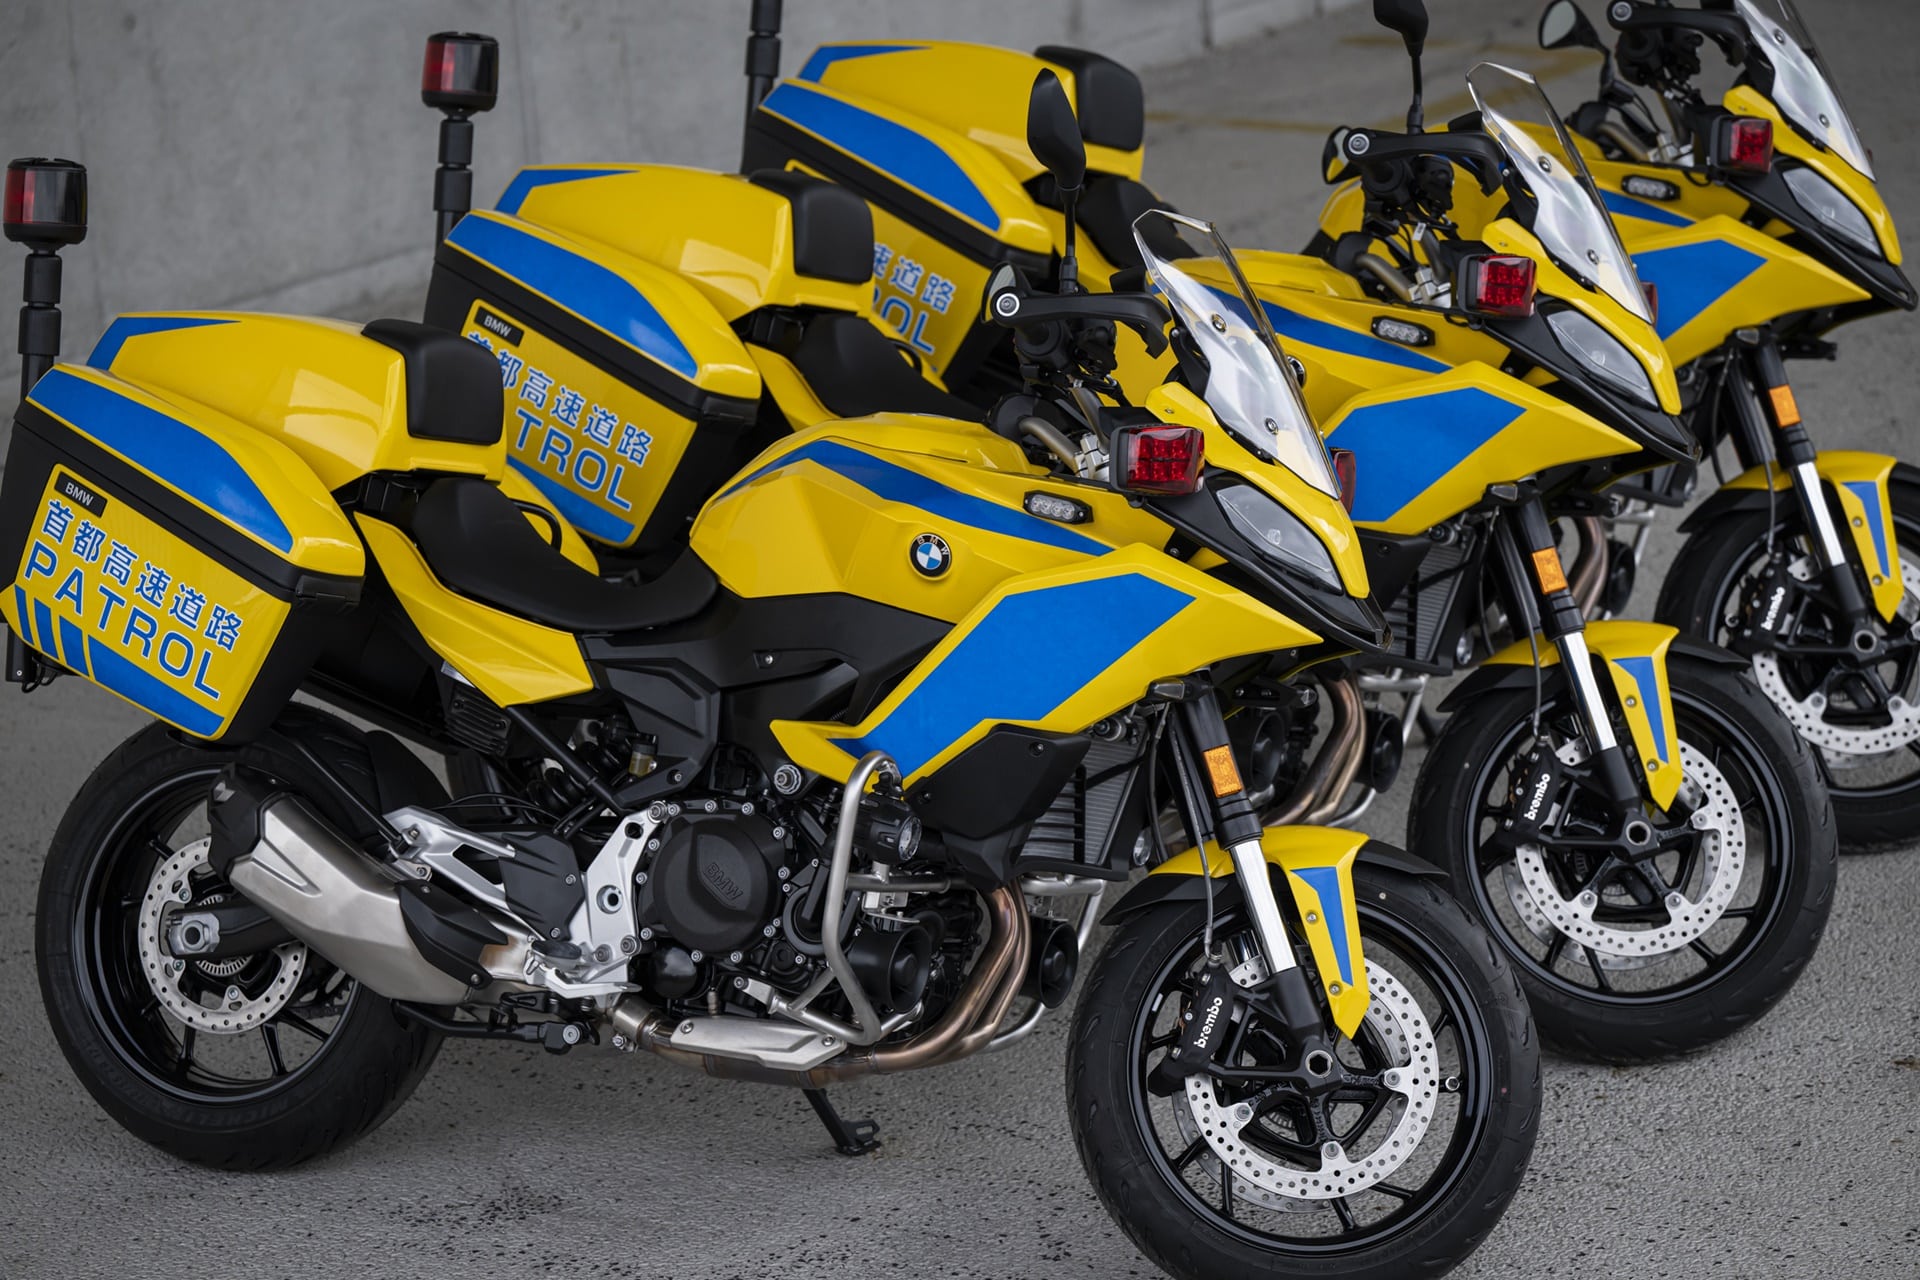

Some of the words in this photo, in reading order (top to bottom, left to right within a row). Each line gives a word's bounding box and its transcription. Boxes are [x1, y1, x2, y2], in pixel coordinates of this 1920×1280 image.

[483, 314, 512, 338] BMW
[64, 481, 94, 507] BMW
[41, 499, 243, 652] 首都高速道路
[24, 540, 221, 700] PATROL
[1760, 586, 1785, 631] brembo
[1523, 773, 1551, 821] brembo
[706, 862, 744, 900] BMW
[1193, 997, 1223, 1049] brembo
